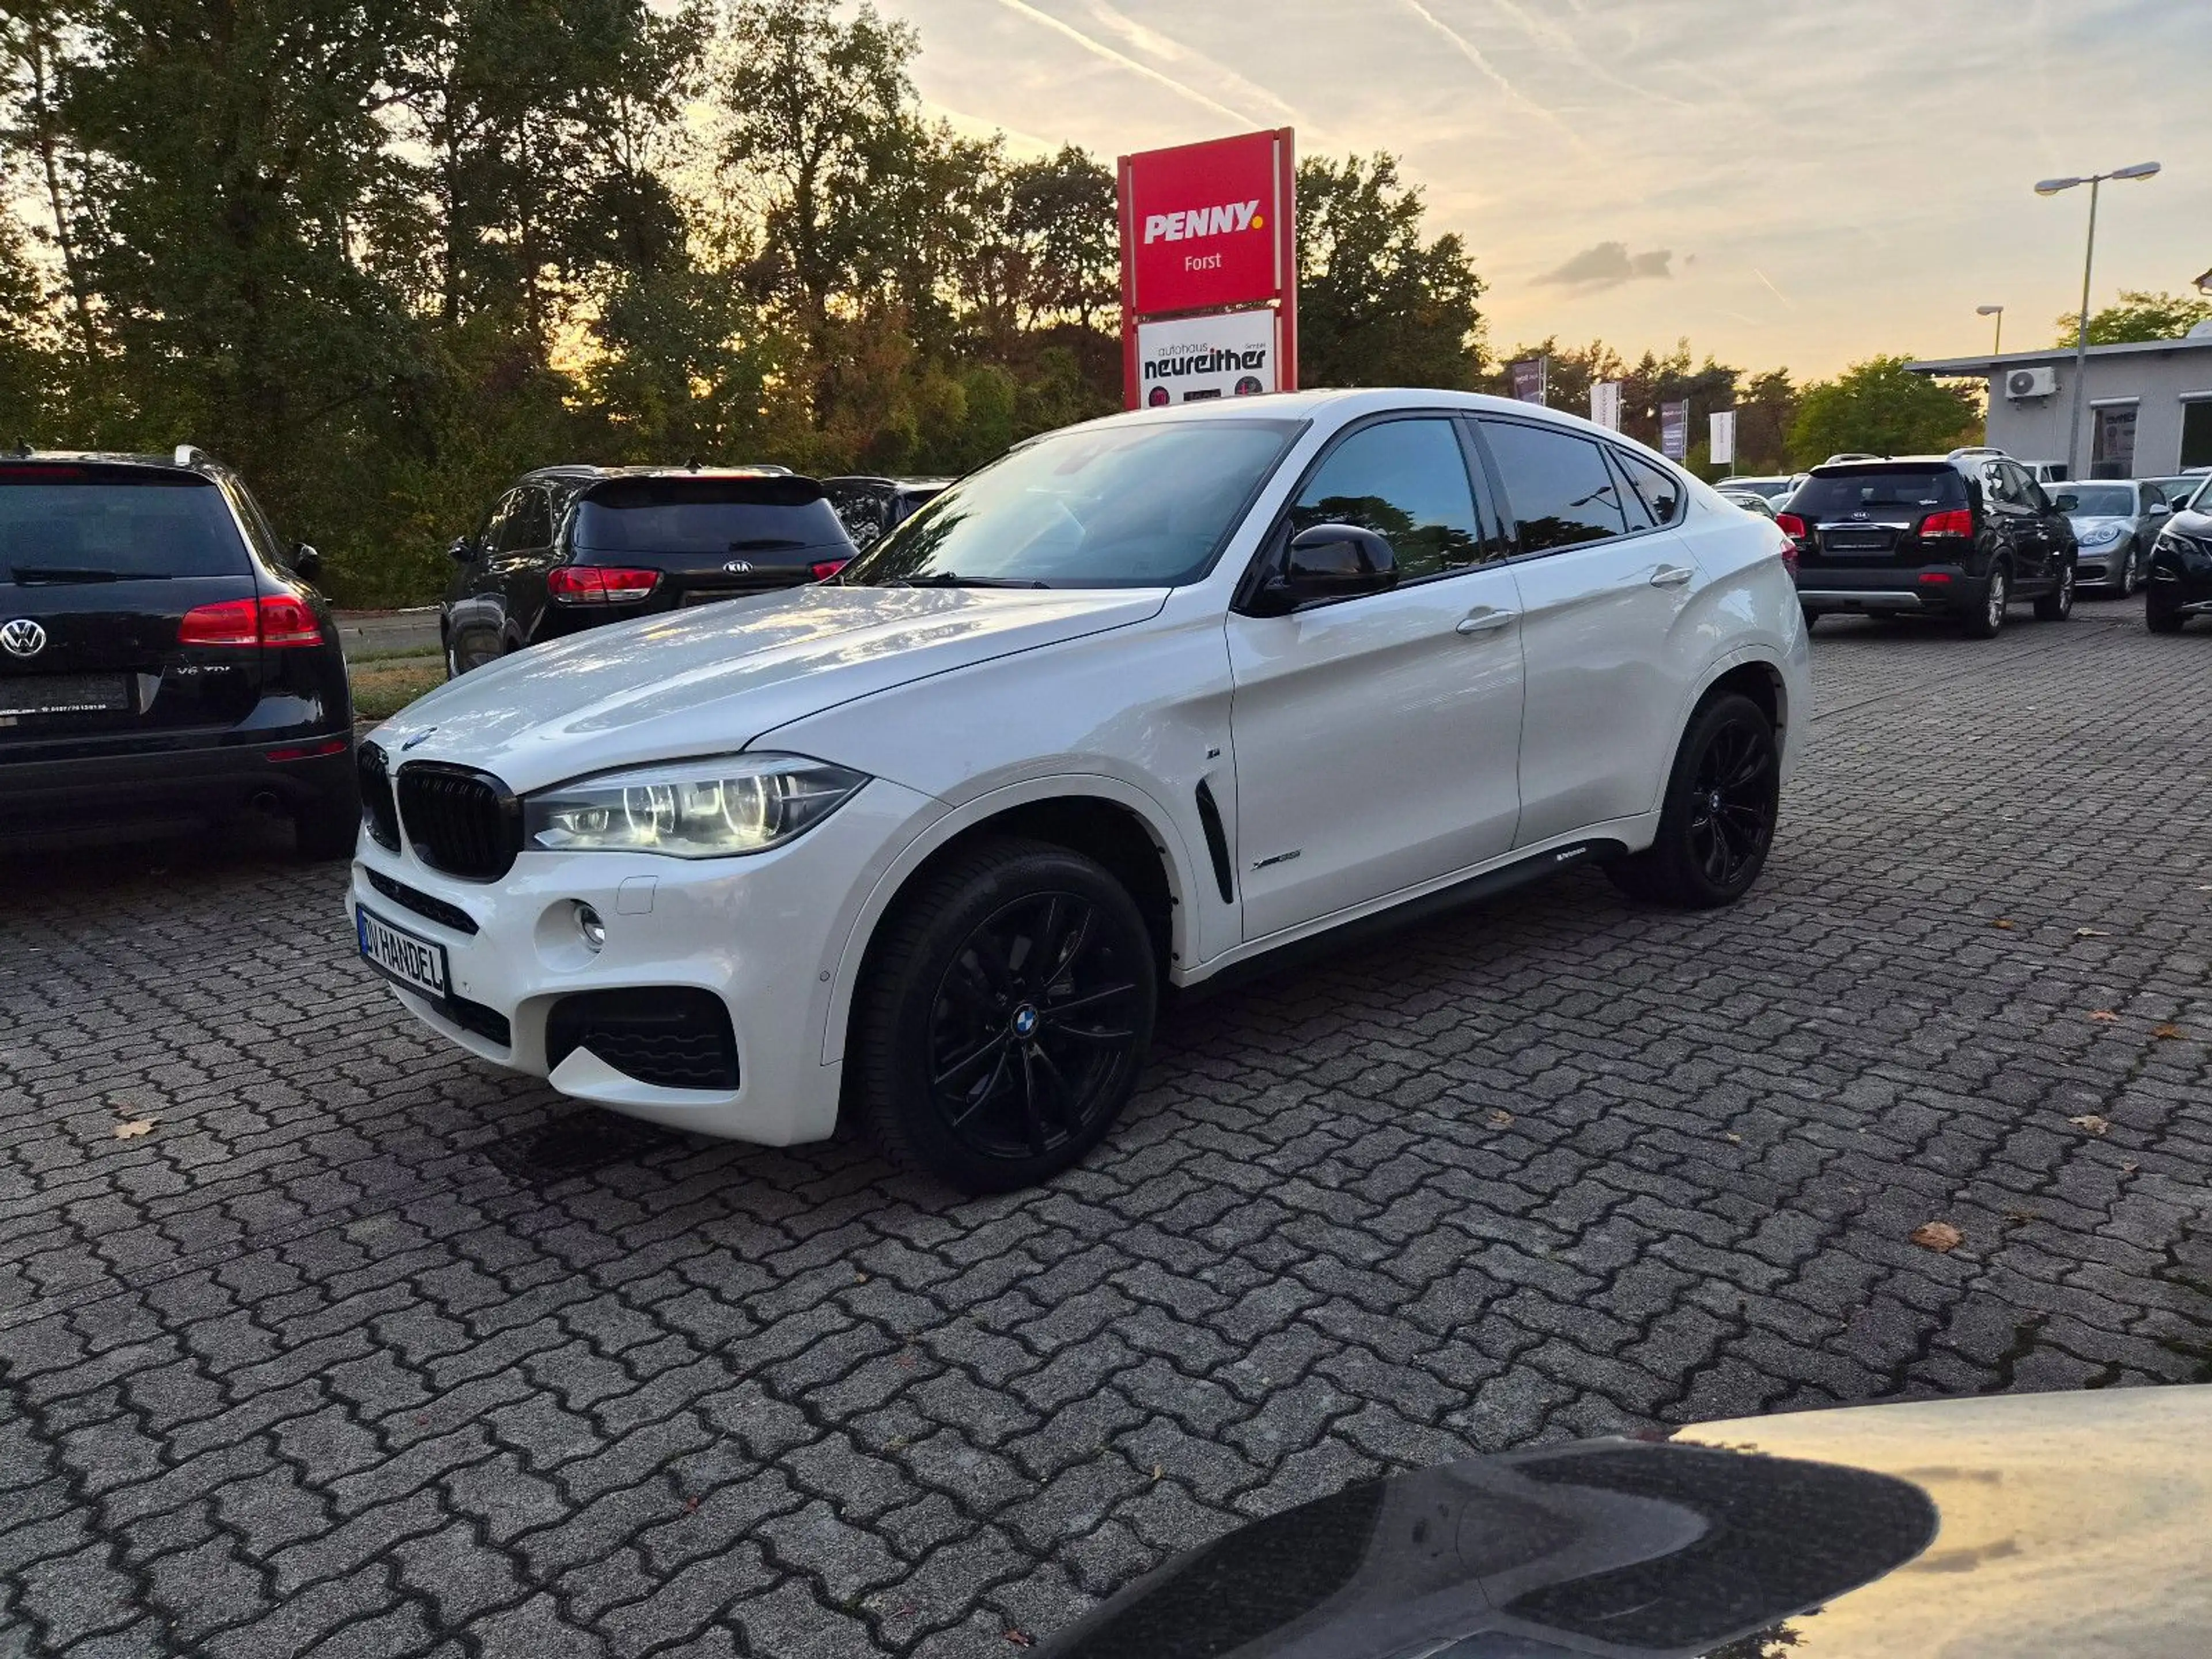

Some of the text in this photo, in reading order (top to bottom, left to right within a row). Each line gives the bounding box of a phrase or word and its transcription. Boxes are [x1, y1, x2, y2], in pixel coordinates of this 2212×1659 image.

[1185, 252, 1222, 272] Forst
[1158, 343, 1208, 357] autohaus
[1144, 347, 1266, 380] neureither
[725, 562, 751, 573] KIA
[176, 666, 198, 675] V6
[379, 926, 443, 992] HANDEL
